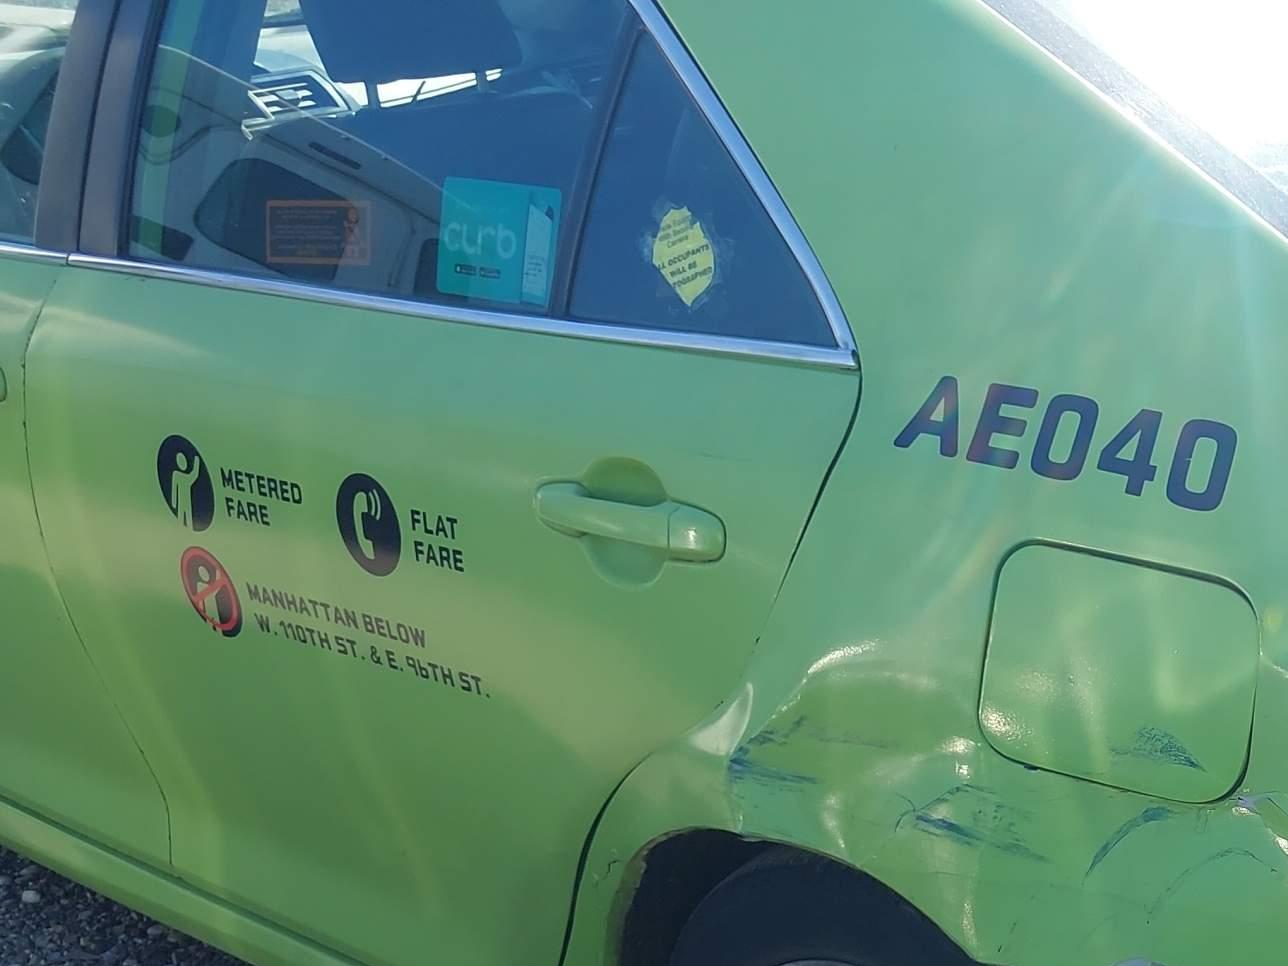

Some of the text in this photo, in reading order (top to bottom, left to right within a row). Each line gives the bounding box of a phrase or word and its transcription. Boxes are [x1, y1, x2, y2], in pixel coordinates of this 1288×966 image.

[444, 222, 517, 260] curb
[668, 244, 710, 266] OCCUPANTS
[688, 260, 698, 270] BE
[893, 375, 1238, 513] AE040
[220, 467, 303, 505] METERED
[224, 497, 271, 527] FARE
[410, 509, 459, 540] FLAT
[413, 541, 465, 573] FARE
[246, 582, 427, 649] MANHATTAN BELOW
[254, 612, 492, 699] W. 110TH ST. & E. 96TH ST.
